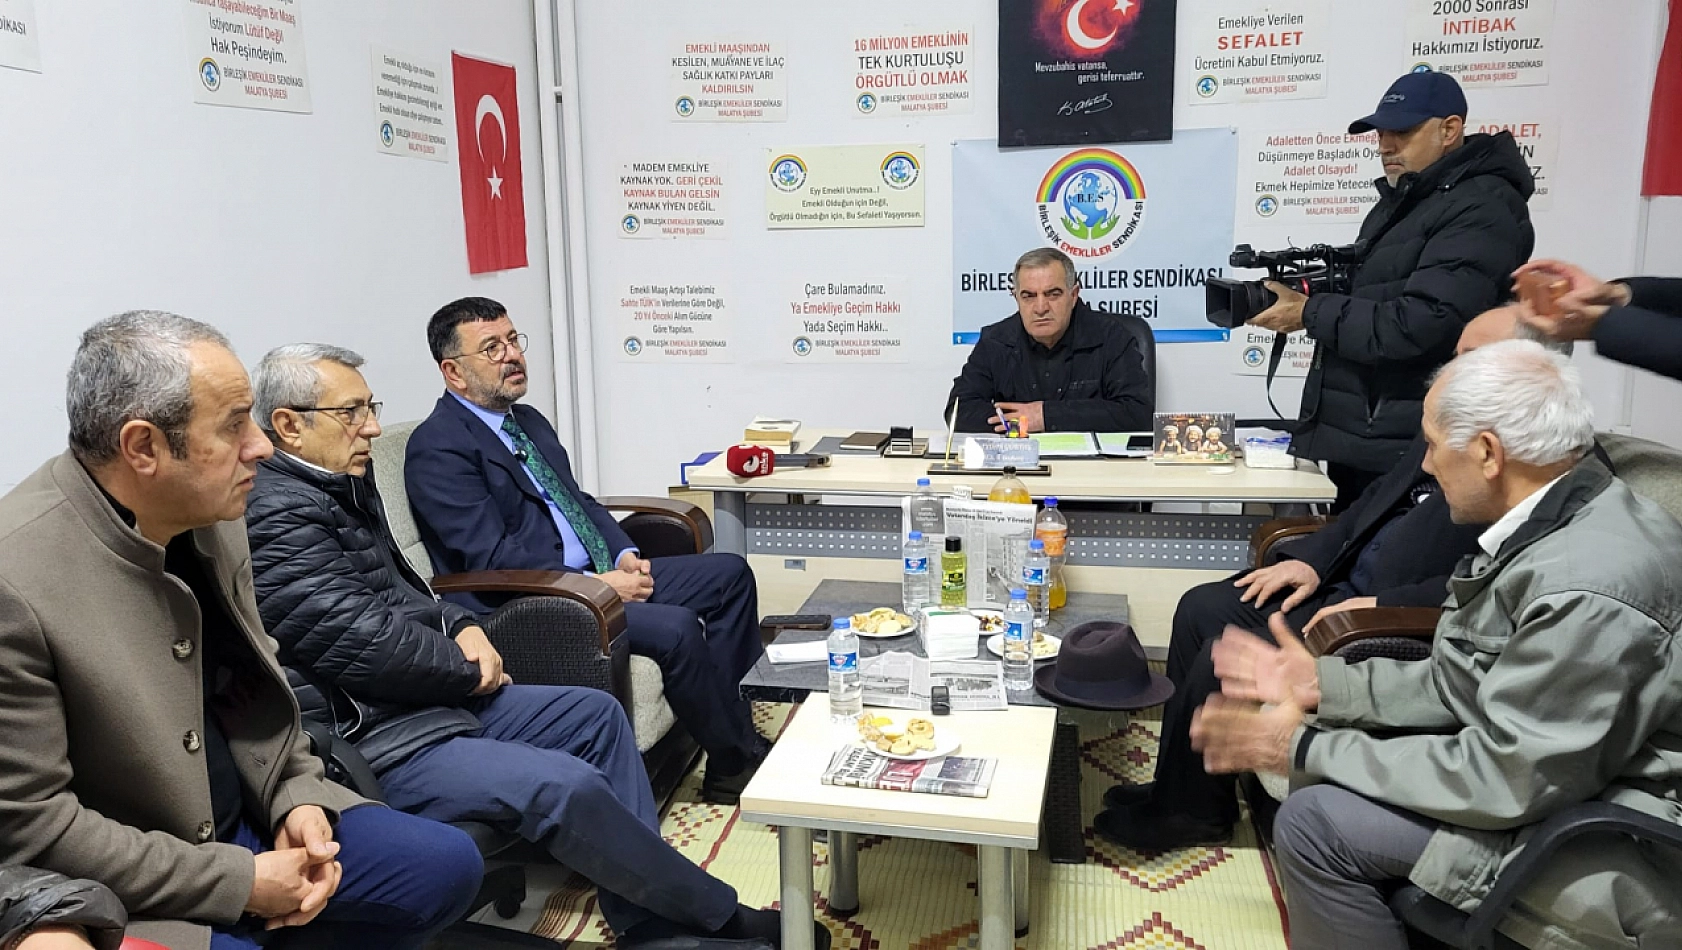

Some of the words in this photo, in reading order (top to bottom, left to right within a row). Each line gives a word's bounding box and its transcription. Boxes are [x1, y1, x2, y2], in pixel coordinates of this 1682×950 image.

[1433, 0, 1471, 15] 2000
[1475, 0, 1529, 12] Sonrası
[1219, 16, 1265, 30] Emekliye
[1267, 13, 1303, 26] Verilen
[1443, 16, 1516, 36] İNTİBAK
[854, 39, 867, 52] 16
[869, 34, 908, 50] MİLYON
[911, 30, 968, 49] EMEKLİNİN
[1218, 31, 1304, 50] SEFALET
[1412, 41, 1479, 56] Hakkımızı
[1482, 35, 1543, 54] İstiyoruz.
[210, 37, 231, 55] Hak
[231, 40, 287, 64] Peşindeyim.
[685, 42, 717, 53] EMEKLİ
[718, 43, 770, 55] MAAŞINDAN
[672, 56, 709, 68] KESİLEN,
[753, 57, 764, 67] VE
[765, 56, 785, 68] İLAÇ
[859, 56, 882, 70] TEK
[886, 51, 963, 68] KURTULUŞU
[1035, 60, 1076, 73] Mevzubahis
[1077, 61, 1107, 71] vatansa,
[1195, 56, 1235, 70] Ücretini
[1238, 54, 1267, 68] Kabul
[1270, 53, 1324, 67] Etmiyoruz.
[1507, 59, 1543, 69] SENDİKASI
[682, 70, 713, 80] SAĞLIK
[714, 70, 738, 79] KATKI
[739, 70, 773, 80] PAYLARI
[855, 70, 916, 89] ÖRGÜTLÜ
[920, 70, 968, 86] OLMAK
[1077, 73, 1099, 85] gerisi
[1287, 73, 1321, 82] SENDİKASI
[702, 84, 754, 94] KALDIRILSIN
[1266, 135, 1314, 146] Adaletten
[1316, 132, 1341, 145] Önce
[1258, 151, 1315, 164] Düşünmeye
[1317, 148, 1359, 162] Başladık
[632, 163, 665, 172] MADEM
[668, 161, 710, 172] EMEKLİYE
[1283, 164, 1315, 177] Adalet
[1317, 163, 1358, 176] Olsaydı!
[620, 176, 653, 185] KAYNAK
[654, 177, 674, 185] YOK.
[677, 174, 696, 185] GERİ
[698, 175, 723, 187] ÇEKİL
[1255, 181, 1287, 192] Ekmek
[1290, 179, 1334, 193] Hepimize
[623, 189, 656, 197] KAYNAK
[658, 190, 686, 198] BULAN
[689, 188, 720, 198] GELSİN
[822, 186, 845, 194] Emekli
[628, 202, 660, 211] KAYNAK
[662, 200, 685, 211] YİYEN
[688, 201, 715, 211] DEĞİL.
[802, 200, 824, 208] Emekli
[1038, 204, 1062, 245] BİRLEŞİK
[1060, 242, 1112, 257] EMEKLİLER
[1112, 202, 1143, 248] SENDİKASI
[630, 285, 650, 294] Emekli
[805, 283, 825, 298] Çare
[828, 283, 886, 294] Bulamadınız.
[691, 298, 706, 307] Göre
[791, 302, 801, 314] Ya
[803, 302, 842, 315] Emekliye
[845, 302, 872, 316] Geçim
[876, 301, 901, 313] Hakkı
[634, 312, 643, 320] 20
[652, 325, 667, 333] Göre
[804, 320, 825, 332] Yada
[827, 320, 854, 335] Seçim
